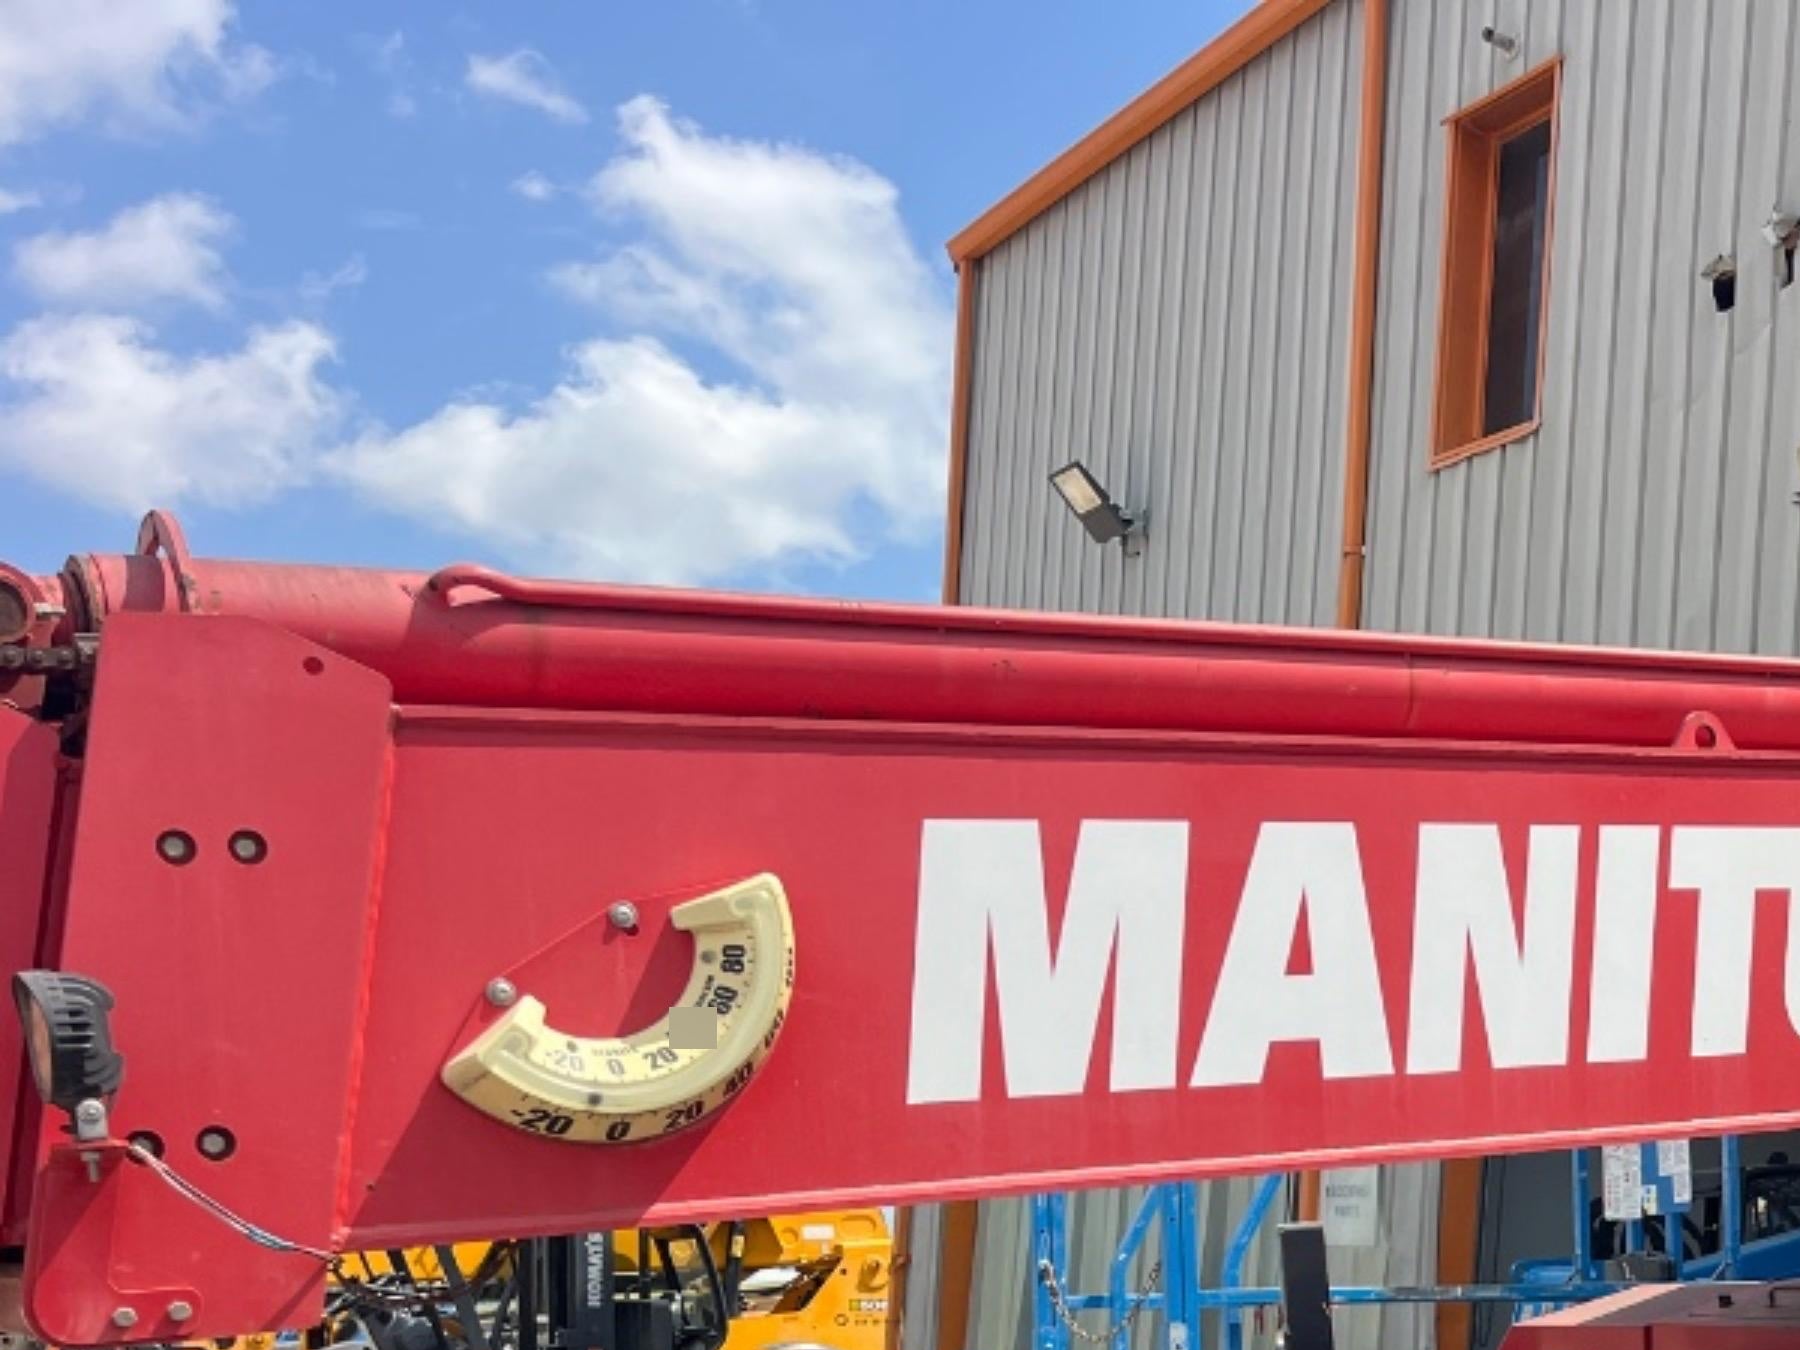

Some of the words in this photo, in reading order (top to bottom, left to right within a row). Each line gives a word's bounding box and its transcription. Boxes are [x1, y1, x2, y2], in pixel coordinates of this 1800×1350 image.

[720, 944, 745, 974] 80
[510, 1108, 574, 1136] -20
[605, 1120, 631, 1141] 0
[665, 1101, 705, 1130] 20
